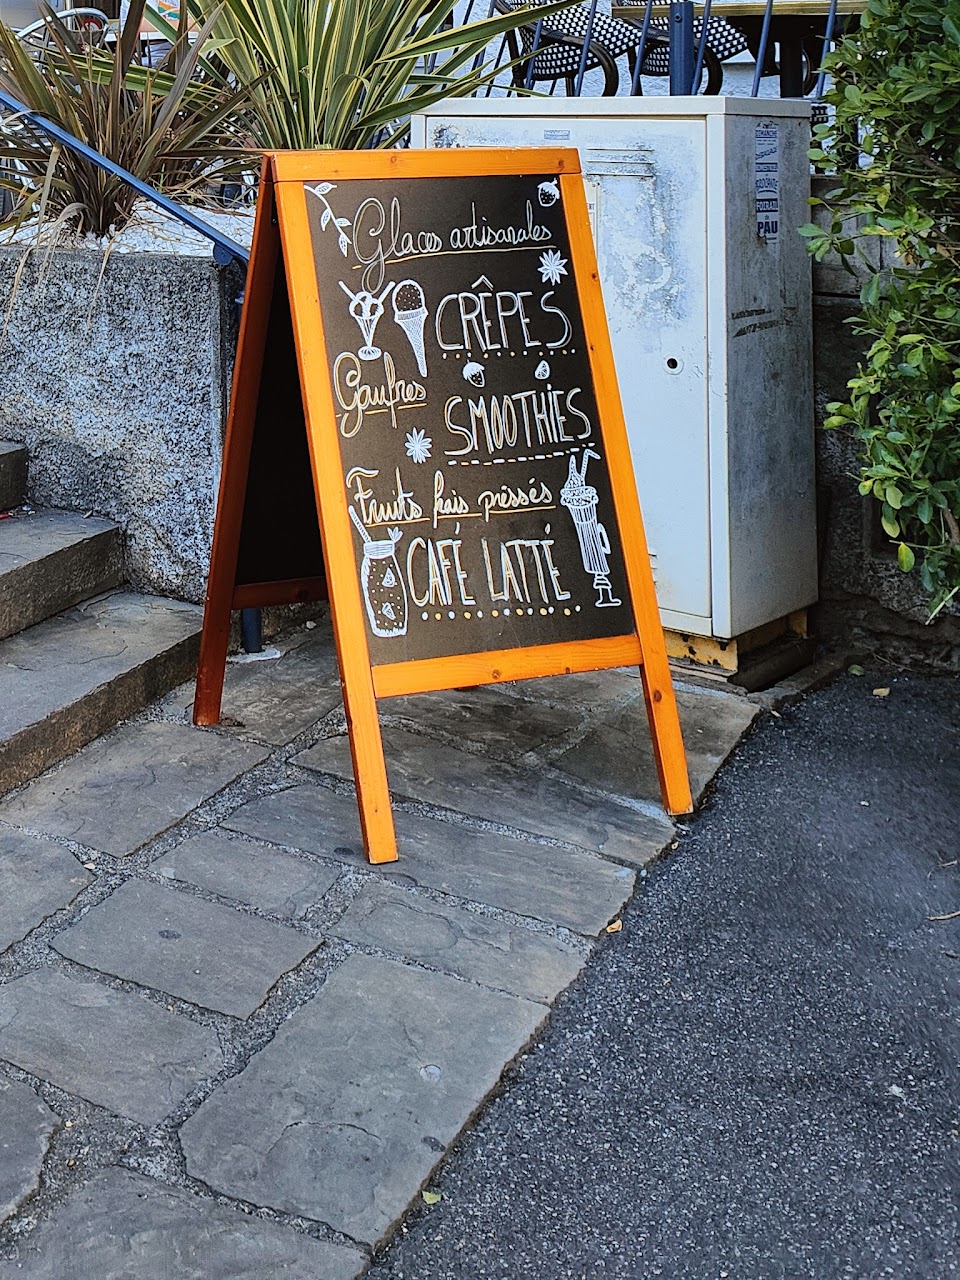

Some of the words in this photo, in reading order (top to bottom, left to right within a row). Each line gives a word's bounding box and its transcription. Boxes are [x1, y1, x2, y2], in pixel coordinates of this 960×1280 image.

[352, 196, 443, 295] Glaces
[450, 200, 552, 249] artisanales
[757, 220, 778, 234] PAU
[435, 274, 573, 352] CRÊPES
[333, 351, 427, 438] Gaufres
[346, 466, 423, 524] Fruits
[433, 470, 470, 529] frais
[406, 521, 477, 607] CAFÉ
